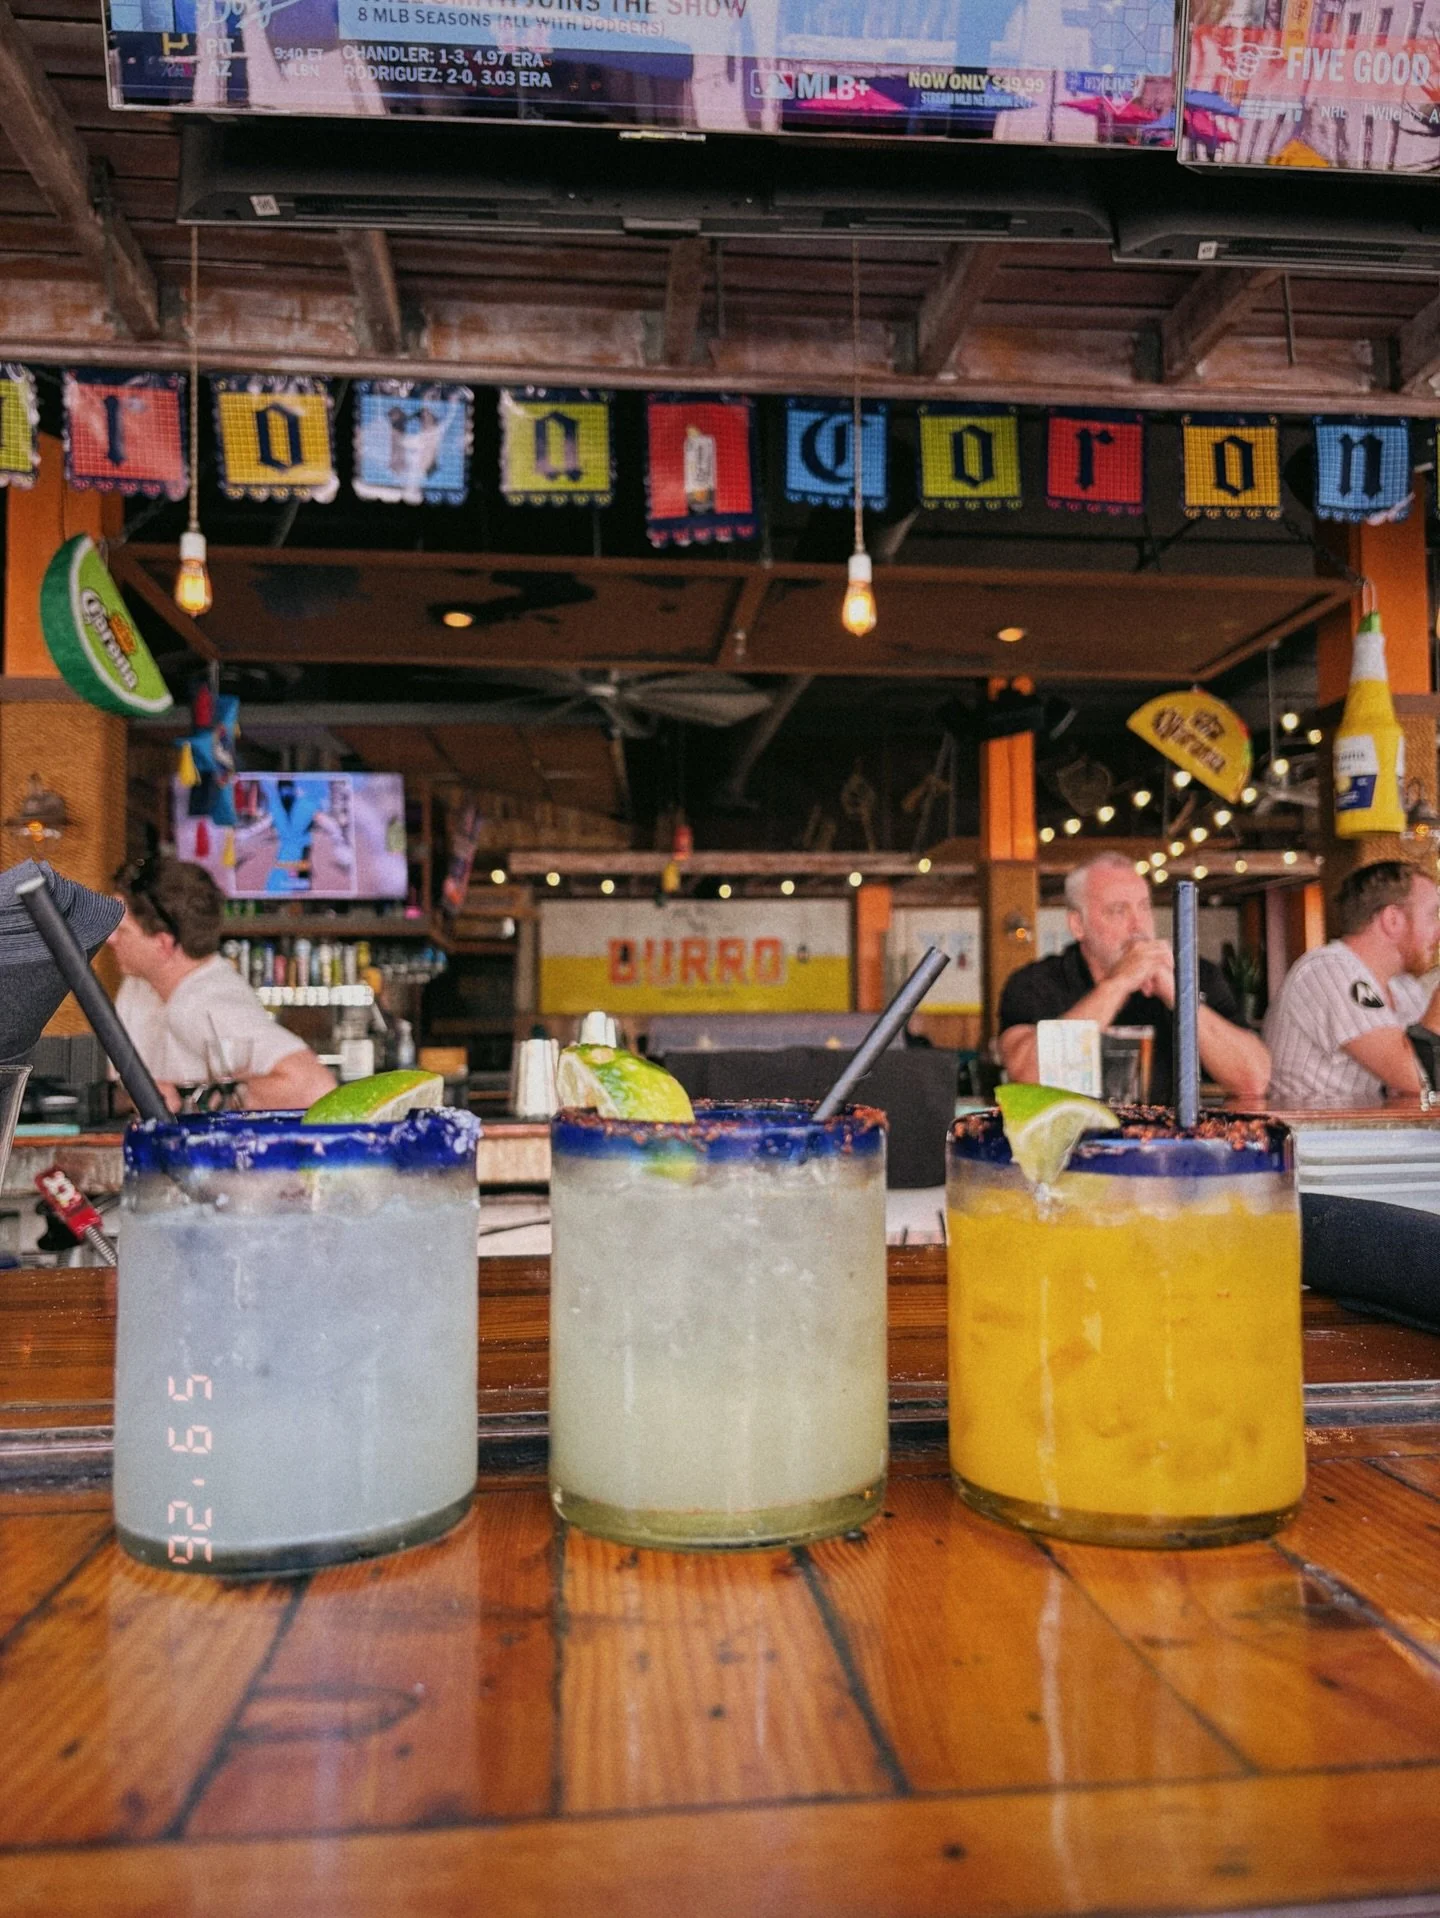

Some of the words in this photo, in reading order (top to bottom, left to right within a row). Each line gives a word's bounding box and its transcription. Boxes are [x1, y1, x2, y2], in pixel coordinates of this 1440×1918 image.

[358, 7, 368, 21] 8
[373, 8, 409, 23] MLB
[415, 9, 491, 27] SEASONS
[667, 0, 747, 18] SHOW
[206, 38, 235, 54] PIT
[274, 46, 302, 61] 9:40
[342, 44, 434, 63] CHANDLER:
[439, 49, 469, 66] 1-3,
[473, 50, 505, 66] 4.97
[511, 51, 545, 67] ERA
[208, 60, 233, 76] AZ
[343, 64, 443, 83] RODRIGUEZ:
[446, 70, 477, 87] 2-0,
[480, 70, 515, 86] 3.03
[518, 71, 552, 87] ERA
[1286, 47, 1346, 83] FIVE
[1353, 51, 1431, 88] GOOD
[797, 71, 870, 101] MLB+
[908, 70, 947, 89] NOW
[949, 73, 989, 91] ONLY
[1320, 105, 1346, 118] NHL
[1371, 106, 1402, 121] Wild
[607, 937, 783, 986] BURRO
